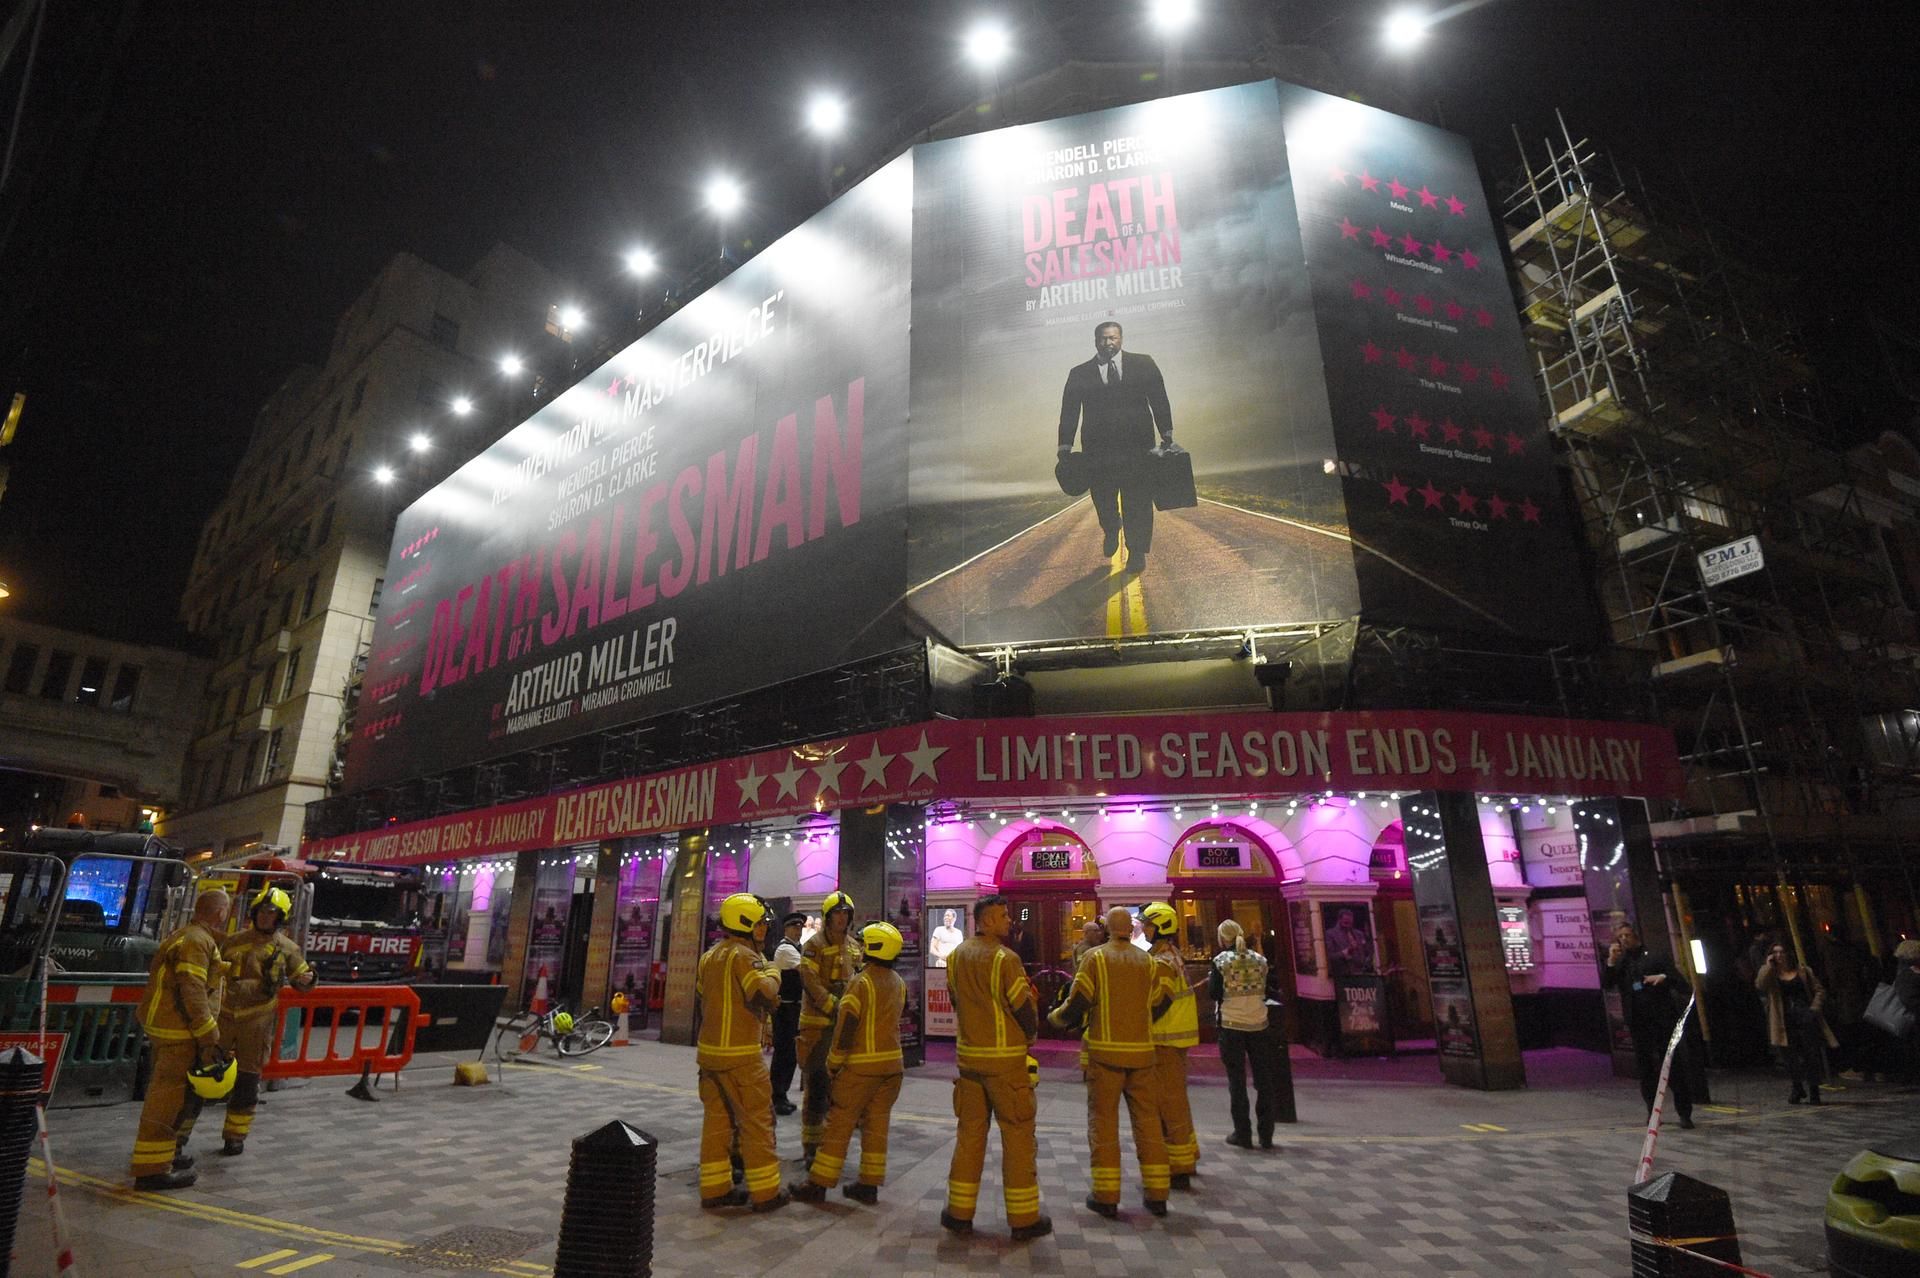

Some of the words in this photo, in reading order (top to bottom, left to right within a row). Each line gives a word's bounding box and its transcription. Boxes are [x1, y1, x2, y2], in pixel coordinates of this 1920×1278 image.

[1022, 171, 1178, 254] DEATH
[1121, 223, 1135, 237] OF
[1136, 221, 1144, 235] A
[1390, 201, 1414, 213] Metro
[1025, 230, 1183, 290] SALESMAN
[1026, 299, 1037, 312] BY
[1039, 277, 1110, 310] ARTHUR
[1114, 266, 1184, 298] MILLER
[1396, 312, 1433, 328] Financial
[1433, 320, 1459, 334] Times
[1419, 378, 1435, 389] The
[1436, 380, 1462, 394] Times
[558, 454, 608, 501] WENDELL
[610, 425, 657, 471] PIERCE
[1419, 443, 1453, 459] Evening
[1454, 449, 1492, 464] Standard
[547, 488, 593, 531] SHARON
[593, 482, 605, 506] D.
[608, 450, 659, 498] CLARKE
[419, 543, 546, 697] DEATH
[540, 376, 866, 647] SALESMAN
[1449, 516, 1472, 529] Time
[1472, 519, 1489, 532] Out
[507, 629, 523, 662] OF
[523, 624, 534, 656] A
[504, 650, 584, 717] ARTHUR
[587, 616, 678, 690] MILLER
[506, 708, 543, 735] MARIANNE
[543, 699, 574, 725] ELLIOTT
[581, 689, 619, 713] MIRANDA
[620, 669, 673, 702] CROMWELL
[976, 732, 1143, 782] LIMITED
[1159, 729, 1330, 779] SEASON
[1345, 727, 1457, 776] ENDS
[1470, 730, 1491, 776] 4
[1504, 731, 1643, 783] JANUARY
[553, 787, 611, 842] DEATH
[608, 767, 718, 834] SALESMAN
[362, 833, 400, 863] LIMITED
[399, 825, 441, 857] SEASON
[441, 820, 473, 852] ENDS
[474, 818, 483, 848] 4
[485, 807, 547, 847] JANUARY
[1207, 848, 1229, 857] BOX
[369, 937, 412, 954] FIRE
[1344, 987, 1377, 1001] TODAY
